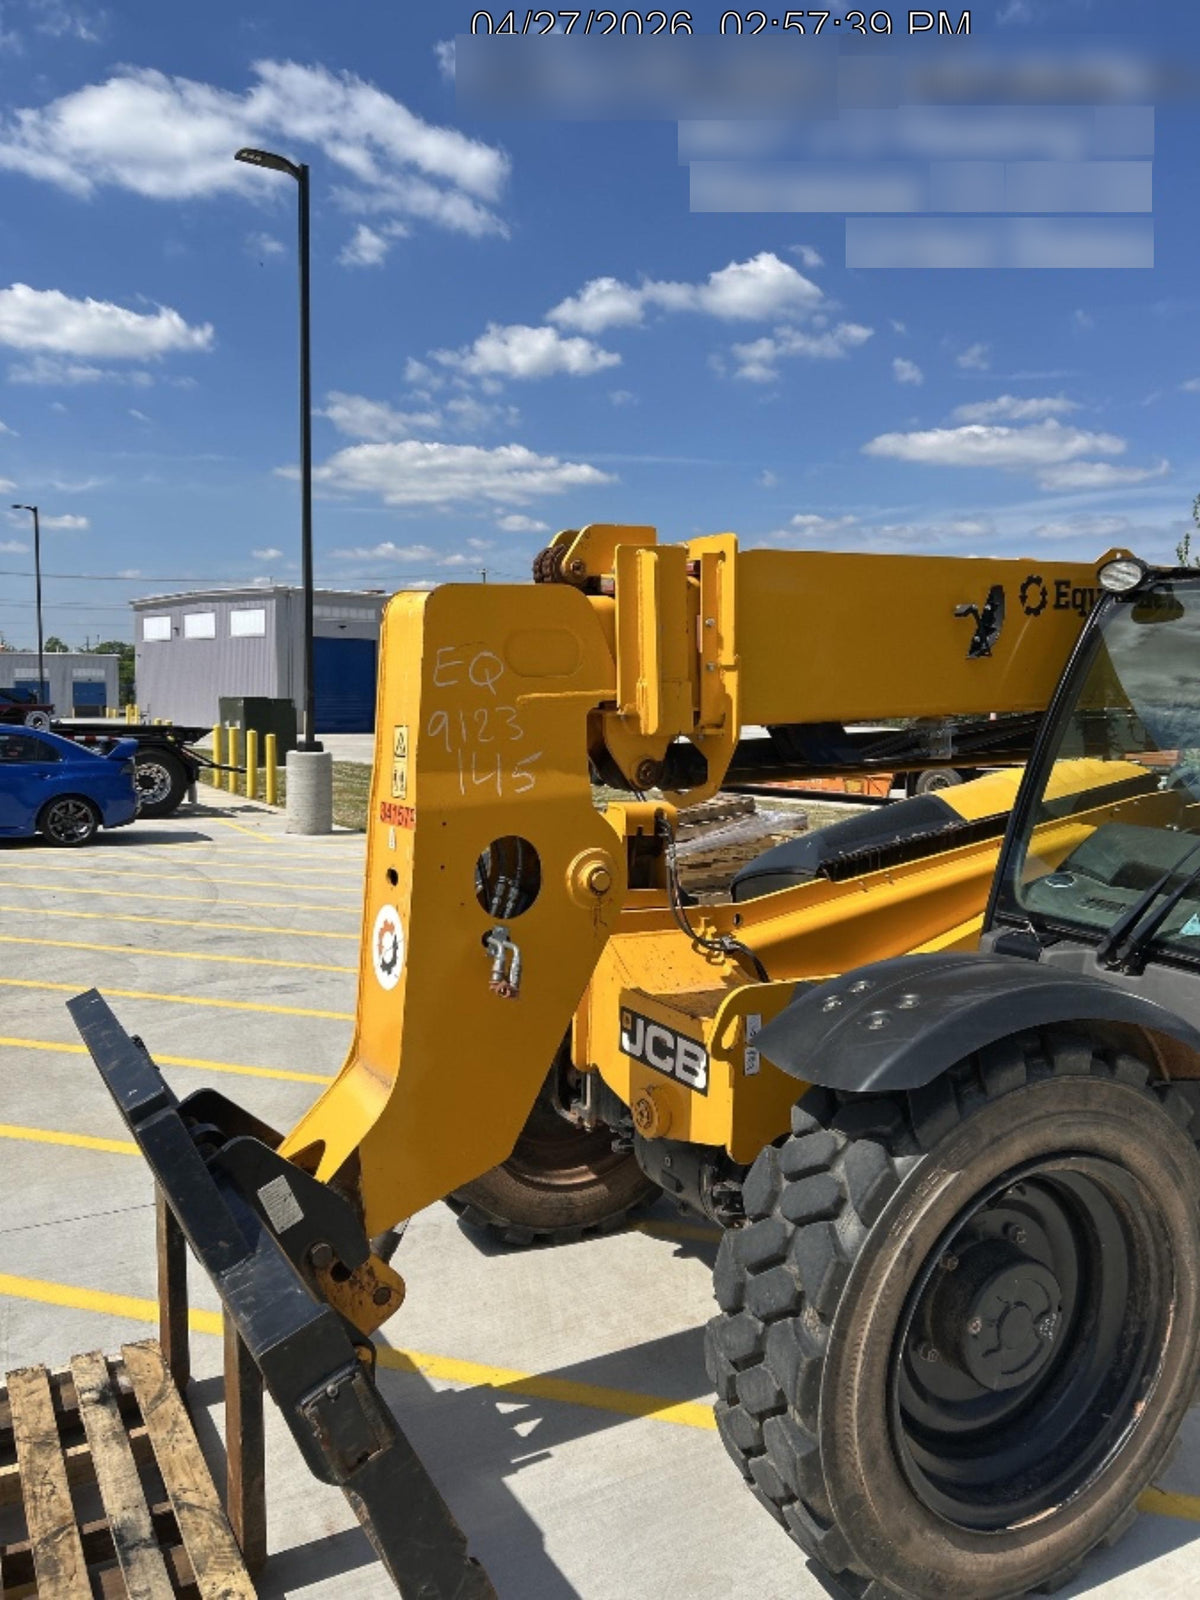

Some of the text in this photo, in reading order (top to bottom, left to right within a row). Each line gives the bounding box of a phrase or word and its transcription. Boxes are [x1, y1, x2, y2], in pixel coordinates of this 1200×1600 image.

[433, 646, 504, 696] EQ
[427, 706, 524, 752] 9123
[457, 748, 543, 797] 145
[621, 1017, 707, 1089] JCB
